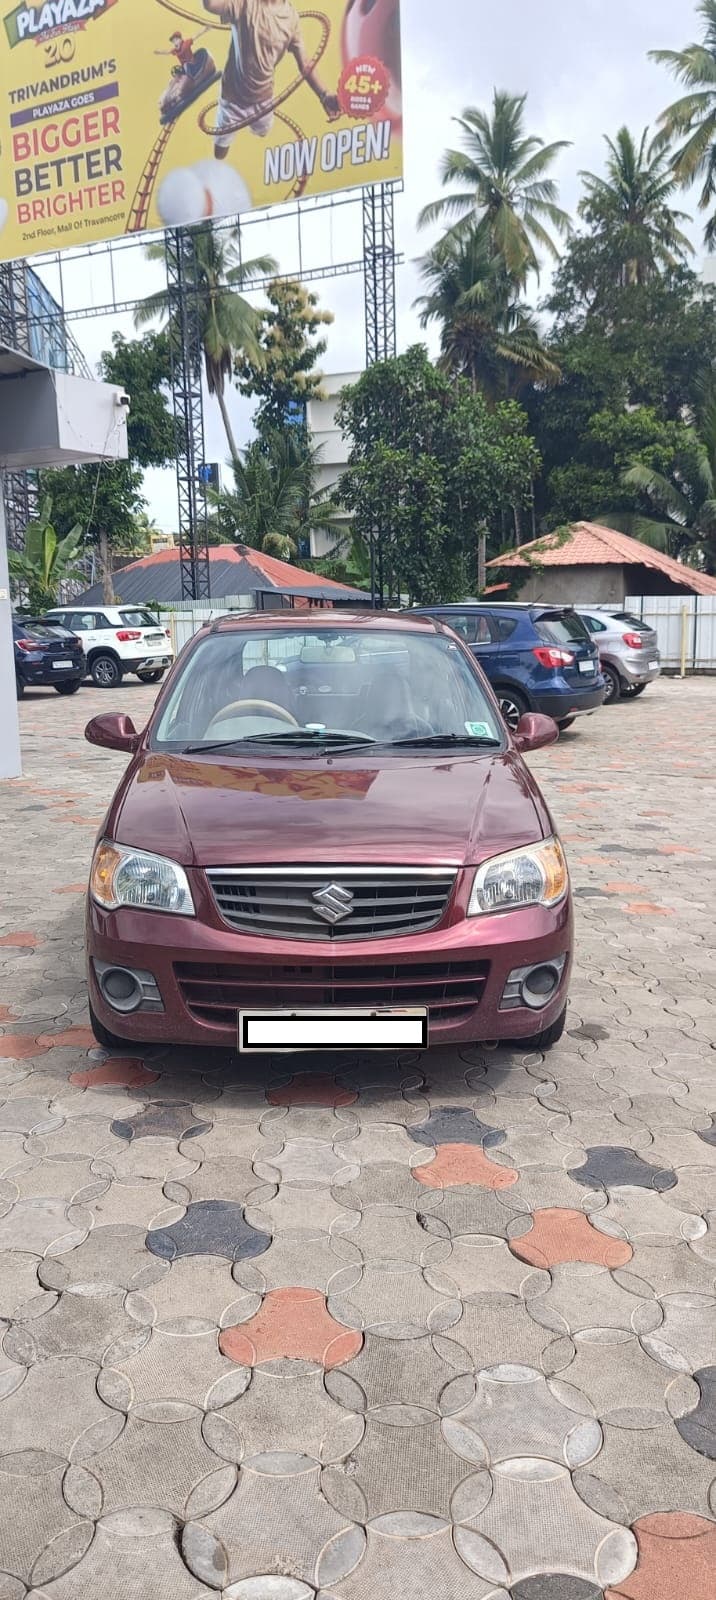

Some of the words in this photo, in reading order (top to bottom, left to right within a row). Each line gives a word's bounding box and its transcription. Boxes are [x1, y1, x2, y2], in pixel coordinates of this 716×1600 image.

[8, 59, 117, 104] TRIVANDRUM'S
[344, 74, 383, 94] 45+
[33, 100, 71, 118] PLAYAZA
[71, 92, 95, 107] GOES
[12, 105, 121, 162] BIGGER
[264, 136, 318, 185] NOW
[320, 119, 392, 172] OPEN!
[14, 143, 123, 197] BETTER
[17, 179, 126, 224] BRIGHTER
[22, 230, 36, 240] 2nd
[36, 227, 56, 238] Floor,
[57, 222, 73, 233] Mall
[73, 220, 83, 230] Of
[83, 212, 126, 228] Travancore
